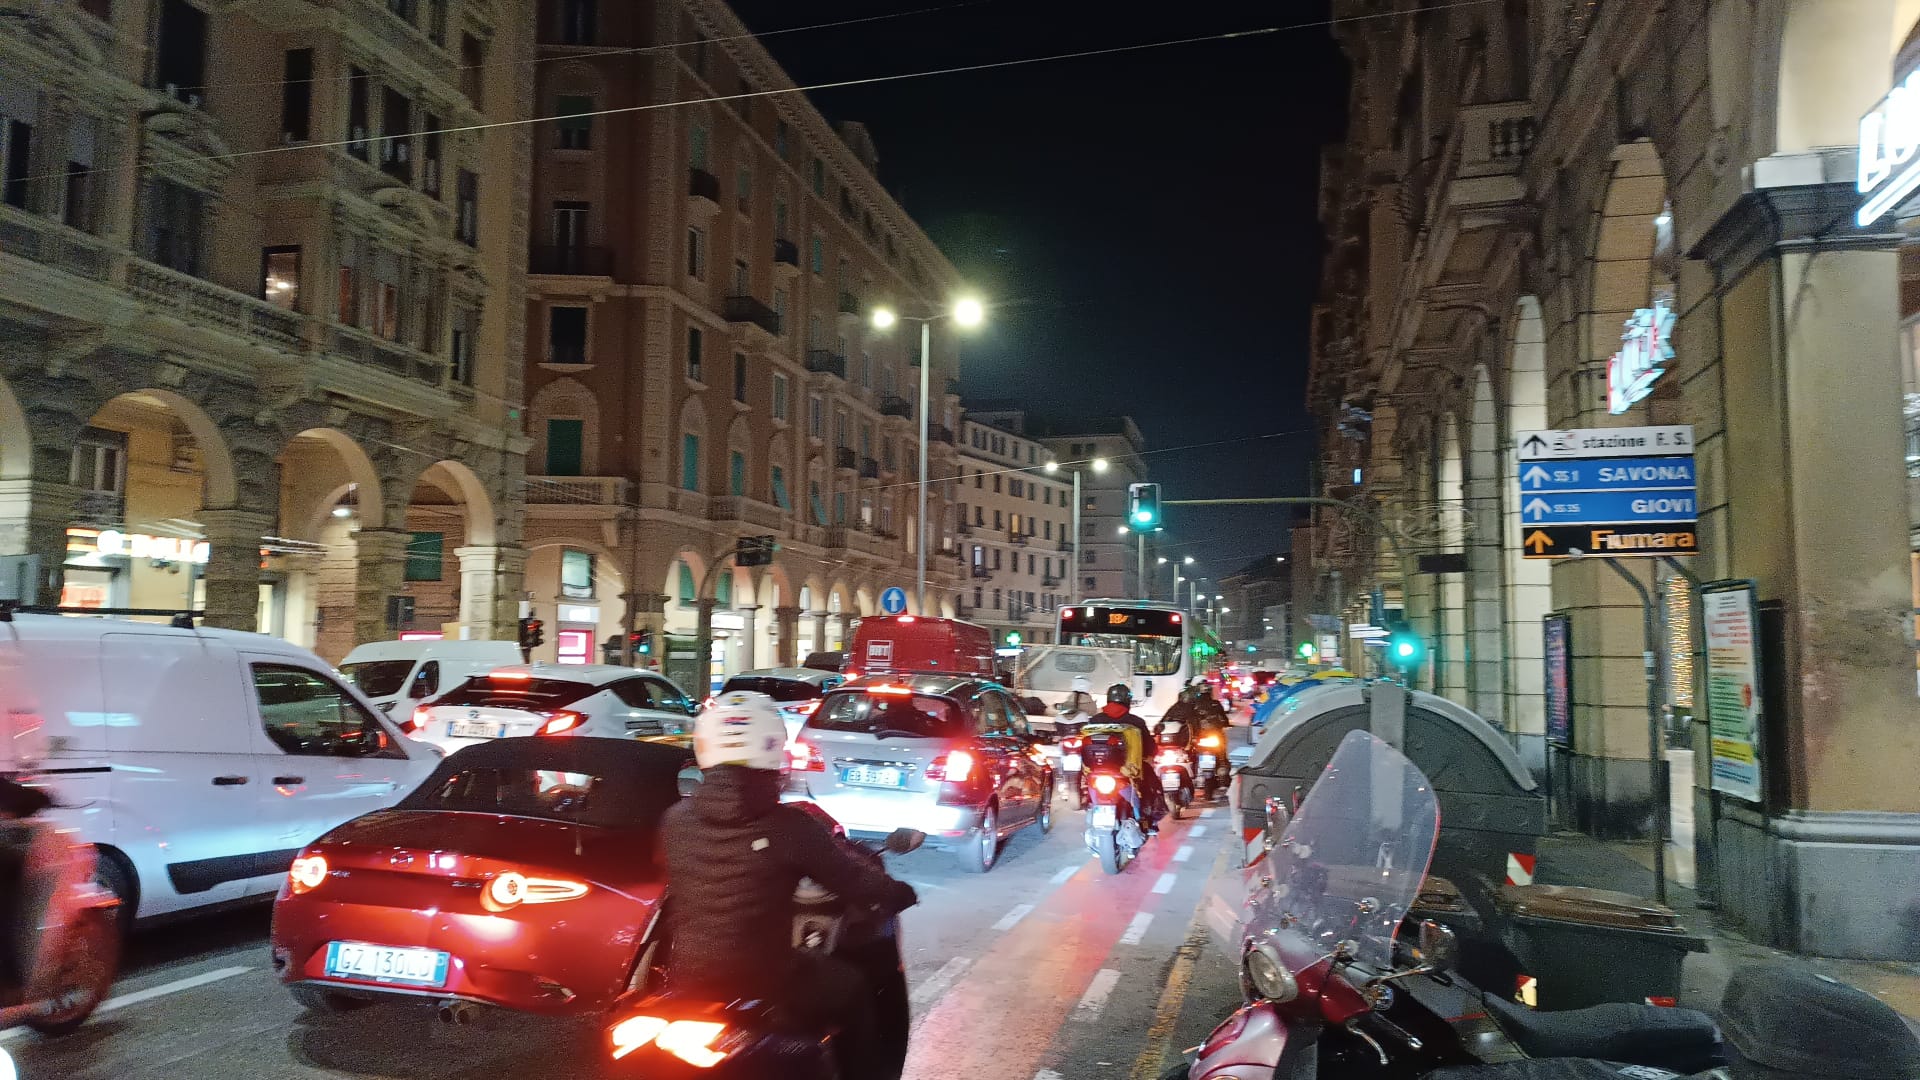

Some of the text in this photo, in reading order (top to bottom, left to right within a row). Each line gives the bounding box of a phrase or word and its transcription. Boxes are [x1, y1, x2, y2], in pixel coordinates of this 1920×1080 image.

[1583, 434, 1647, 449] stazione
[1598, 465, 1691, 482] SAVONA
[1631, 498, 1692, 514] GIOVI
[1591, 529, 1695, 550] Fiumara
